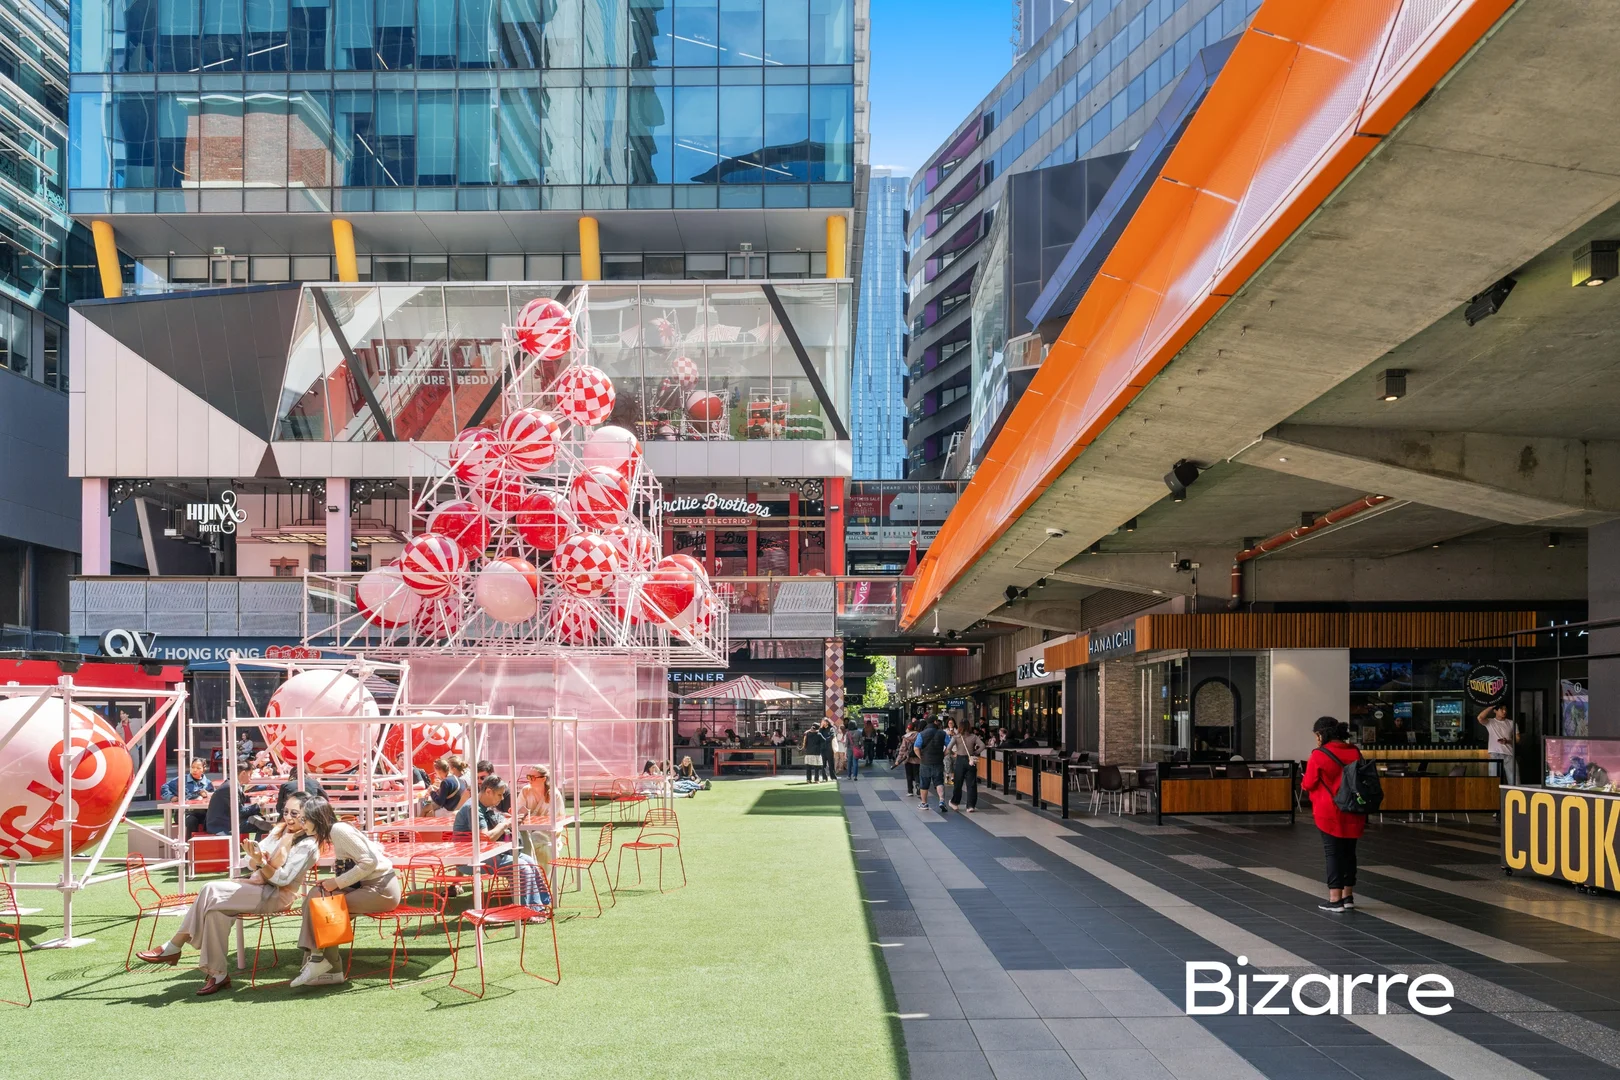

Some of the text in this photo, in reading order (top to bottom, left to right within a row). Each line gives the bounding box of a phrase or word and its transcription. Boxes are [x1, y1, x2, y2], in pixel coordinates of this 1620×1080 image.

[457, 375, 499, 385] BEDDIN
[186, 490, 247, 534] HIJINX
[701, 493, 771, 517] Brothers
[199, 524, 221, 533] HOTEL
[102, 628, 161, 658] QV
[1088, 629, 1132, 655] HANAICHI
[165, 647, 211, 660] HONG
[215, 647, 260, 660] KONG
[667, 673, 724, 681] RENNER
